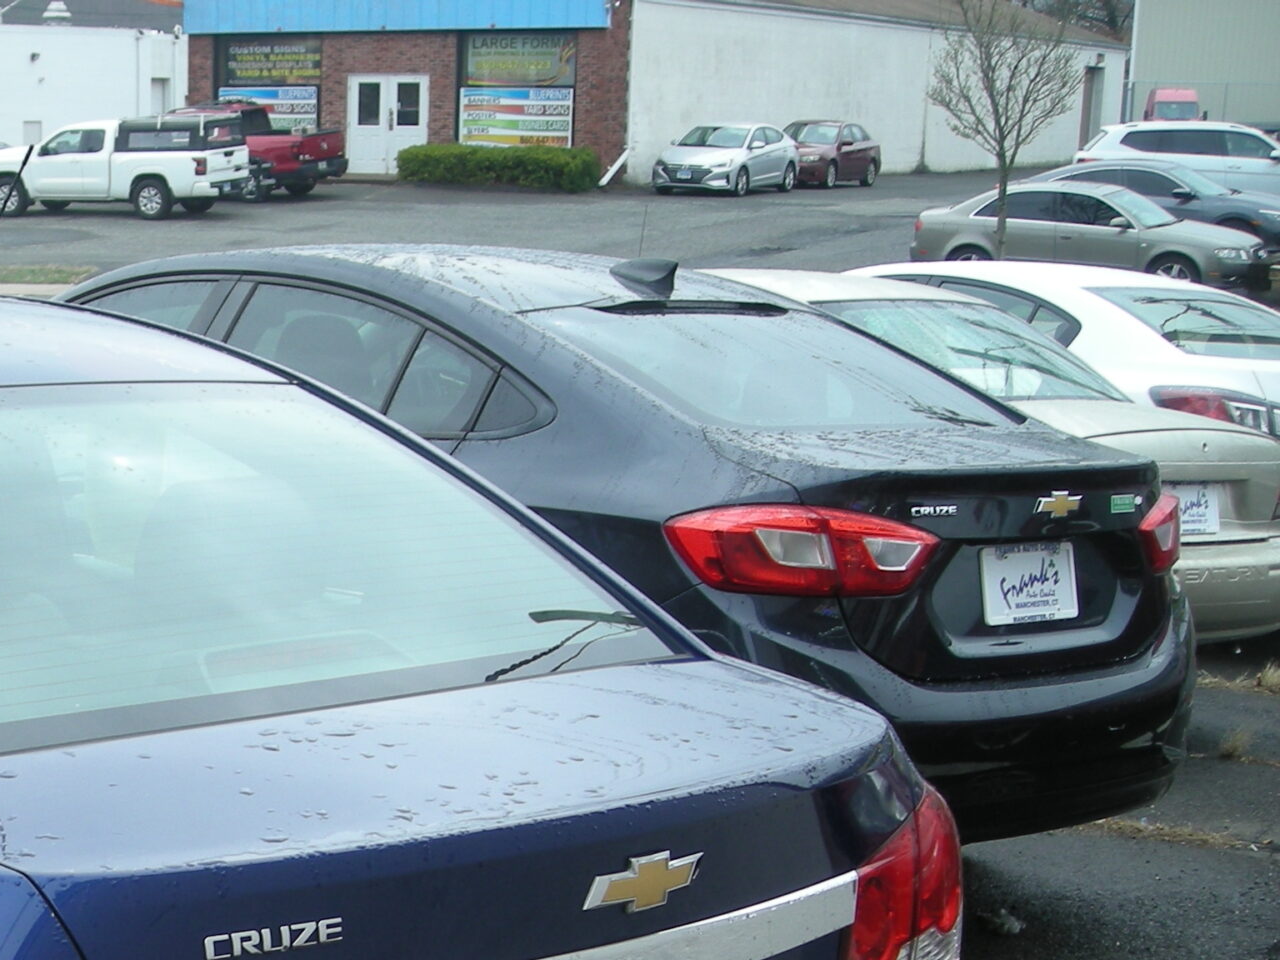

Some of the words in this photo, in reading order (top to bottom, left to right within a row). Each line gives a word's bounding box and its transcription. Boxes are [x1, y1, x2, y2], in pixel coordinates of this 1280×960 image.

[472, 37, 517, 49] LARGE
[228, 46, 271, 54] CUSTOM
[273, 46, 306, 54] SIGNS
[529, 89, 570, 100] BLUEPRINTS
[293, 104, 315, 113] SIGNS
[524, 105, 544, 114] YARD
[545, 105, 569, 115] SIGNS
[467, 112, 497, 120] POSTERS
[546, 120, 569, 130] CARDS
[910, 505, 958, 517] CRUZE
[1000, 557, 1061, 610] Frank's
[204, 917, 344, 960] CRUZE
